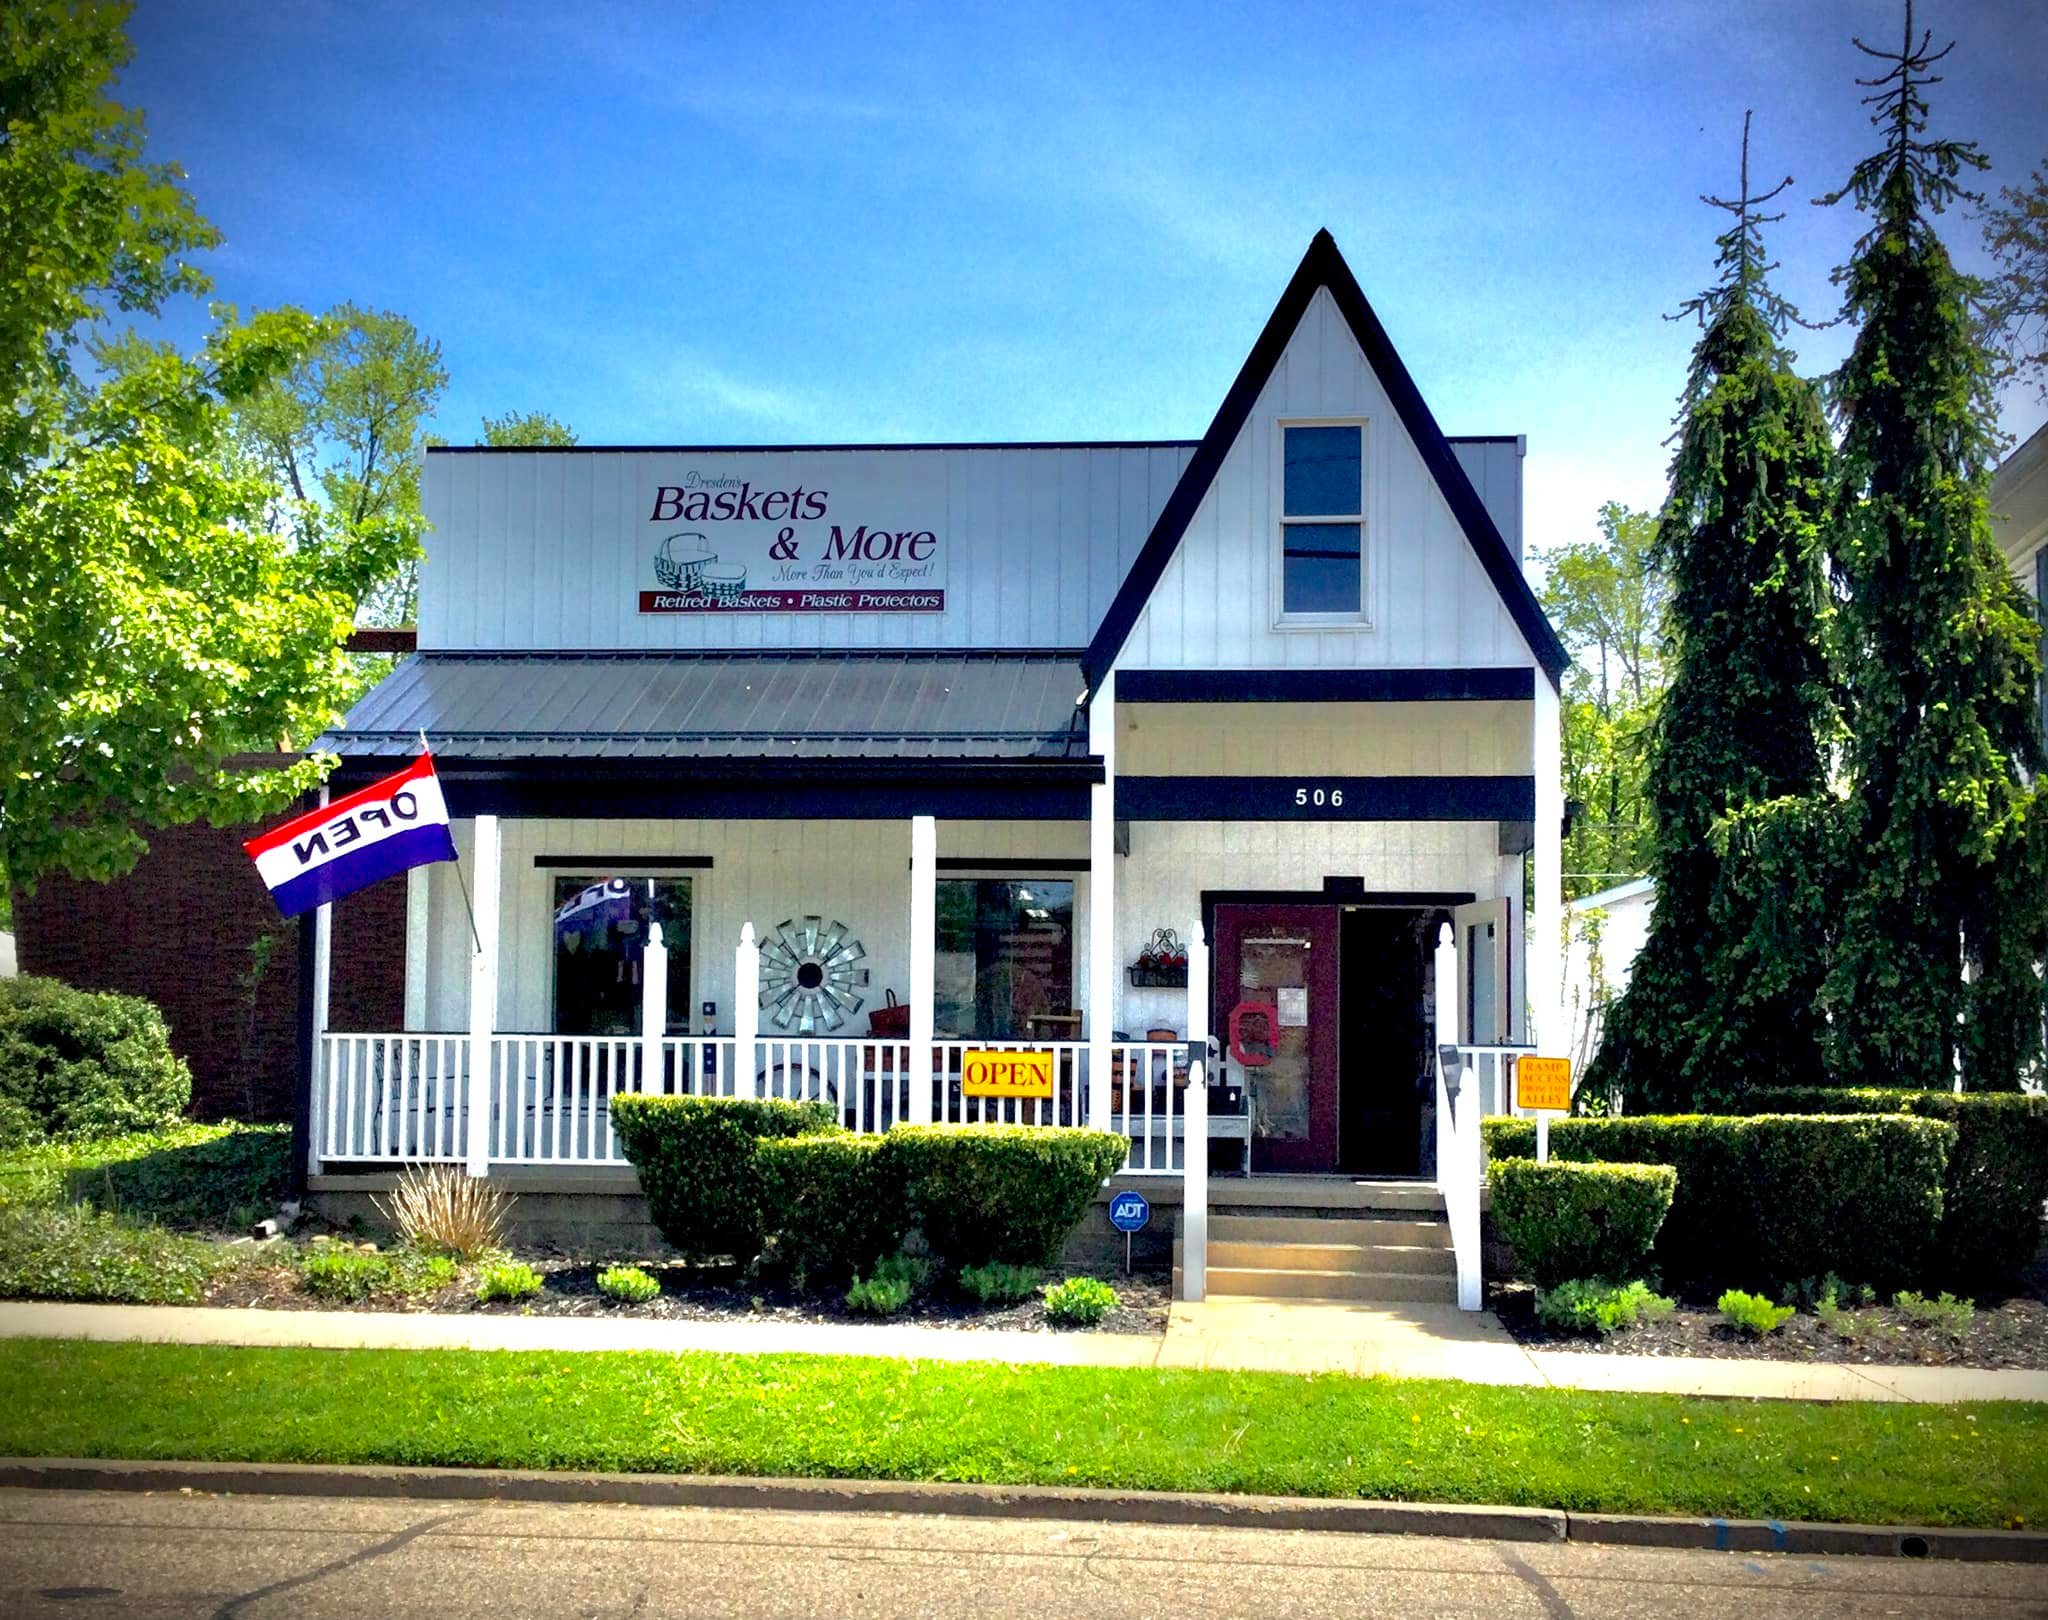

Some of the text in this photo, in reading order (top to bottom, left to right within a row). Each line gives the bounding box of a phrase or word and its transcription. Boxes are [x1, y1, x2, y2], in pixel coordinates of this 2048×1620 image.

[649, 482, 829, 521] Baskets
[768, 525, 937, 561] & More
[772, 562, 935, 586] More Than You'd Expect!
[653, 593, 940, 608] Retired Baskets Plastic Protectors
[1295, 788, 1344, 807] 506
[966, 1061, 1050, 1088] OPEN
[1525, 1062, 1564, 1073] RAMP
[1521, 1073, 1568, 1083] ACCESS
[1524, 1094, 1563, 1105] ALLEY
[1114, 1203, 1145, 1218] ADT
